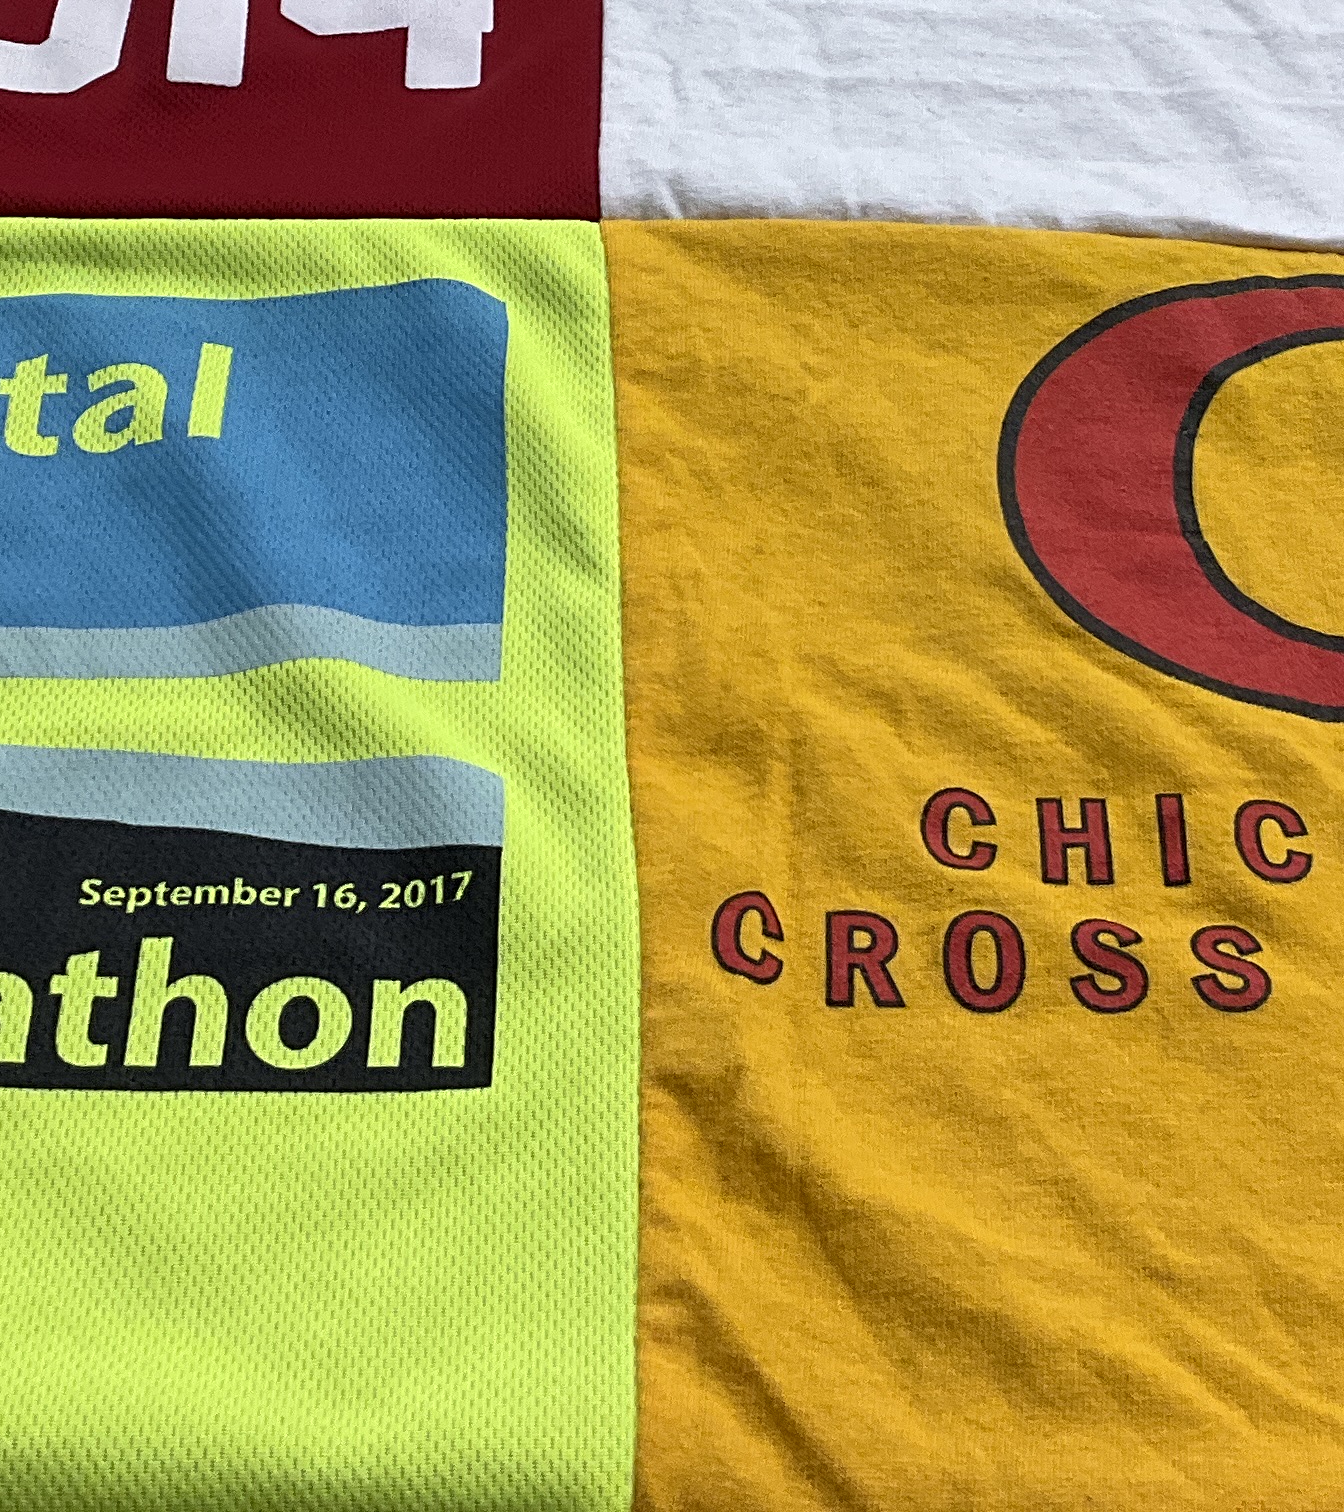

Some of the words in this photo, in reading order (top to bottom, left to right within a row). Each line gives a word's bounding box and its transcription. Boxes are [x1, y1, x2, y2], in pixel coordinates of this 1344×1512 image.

[78, 876, 299, 915] September
[311, 881, 368, 914] 16,
[378, 870, 474, 911] 2017
[710, 890, 1272, 1014] CROSS
